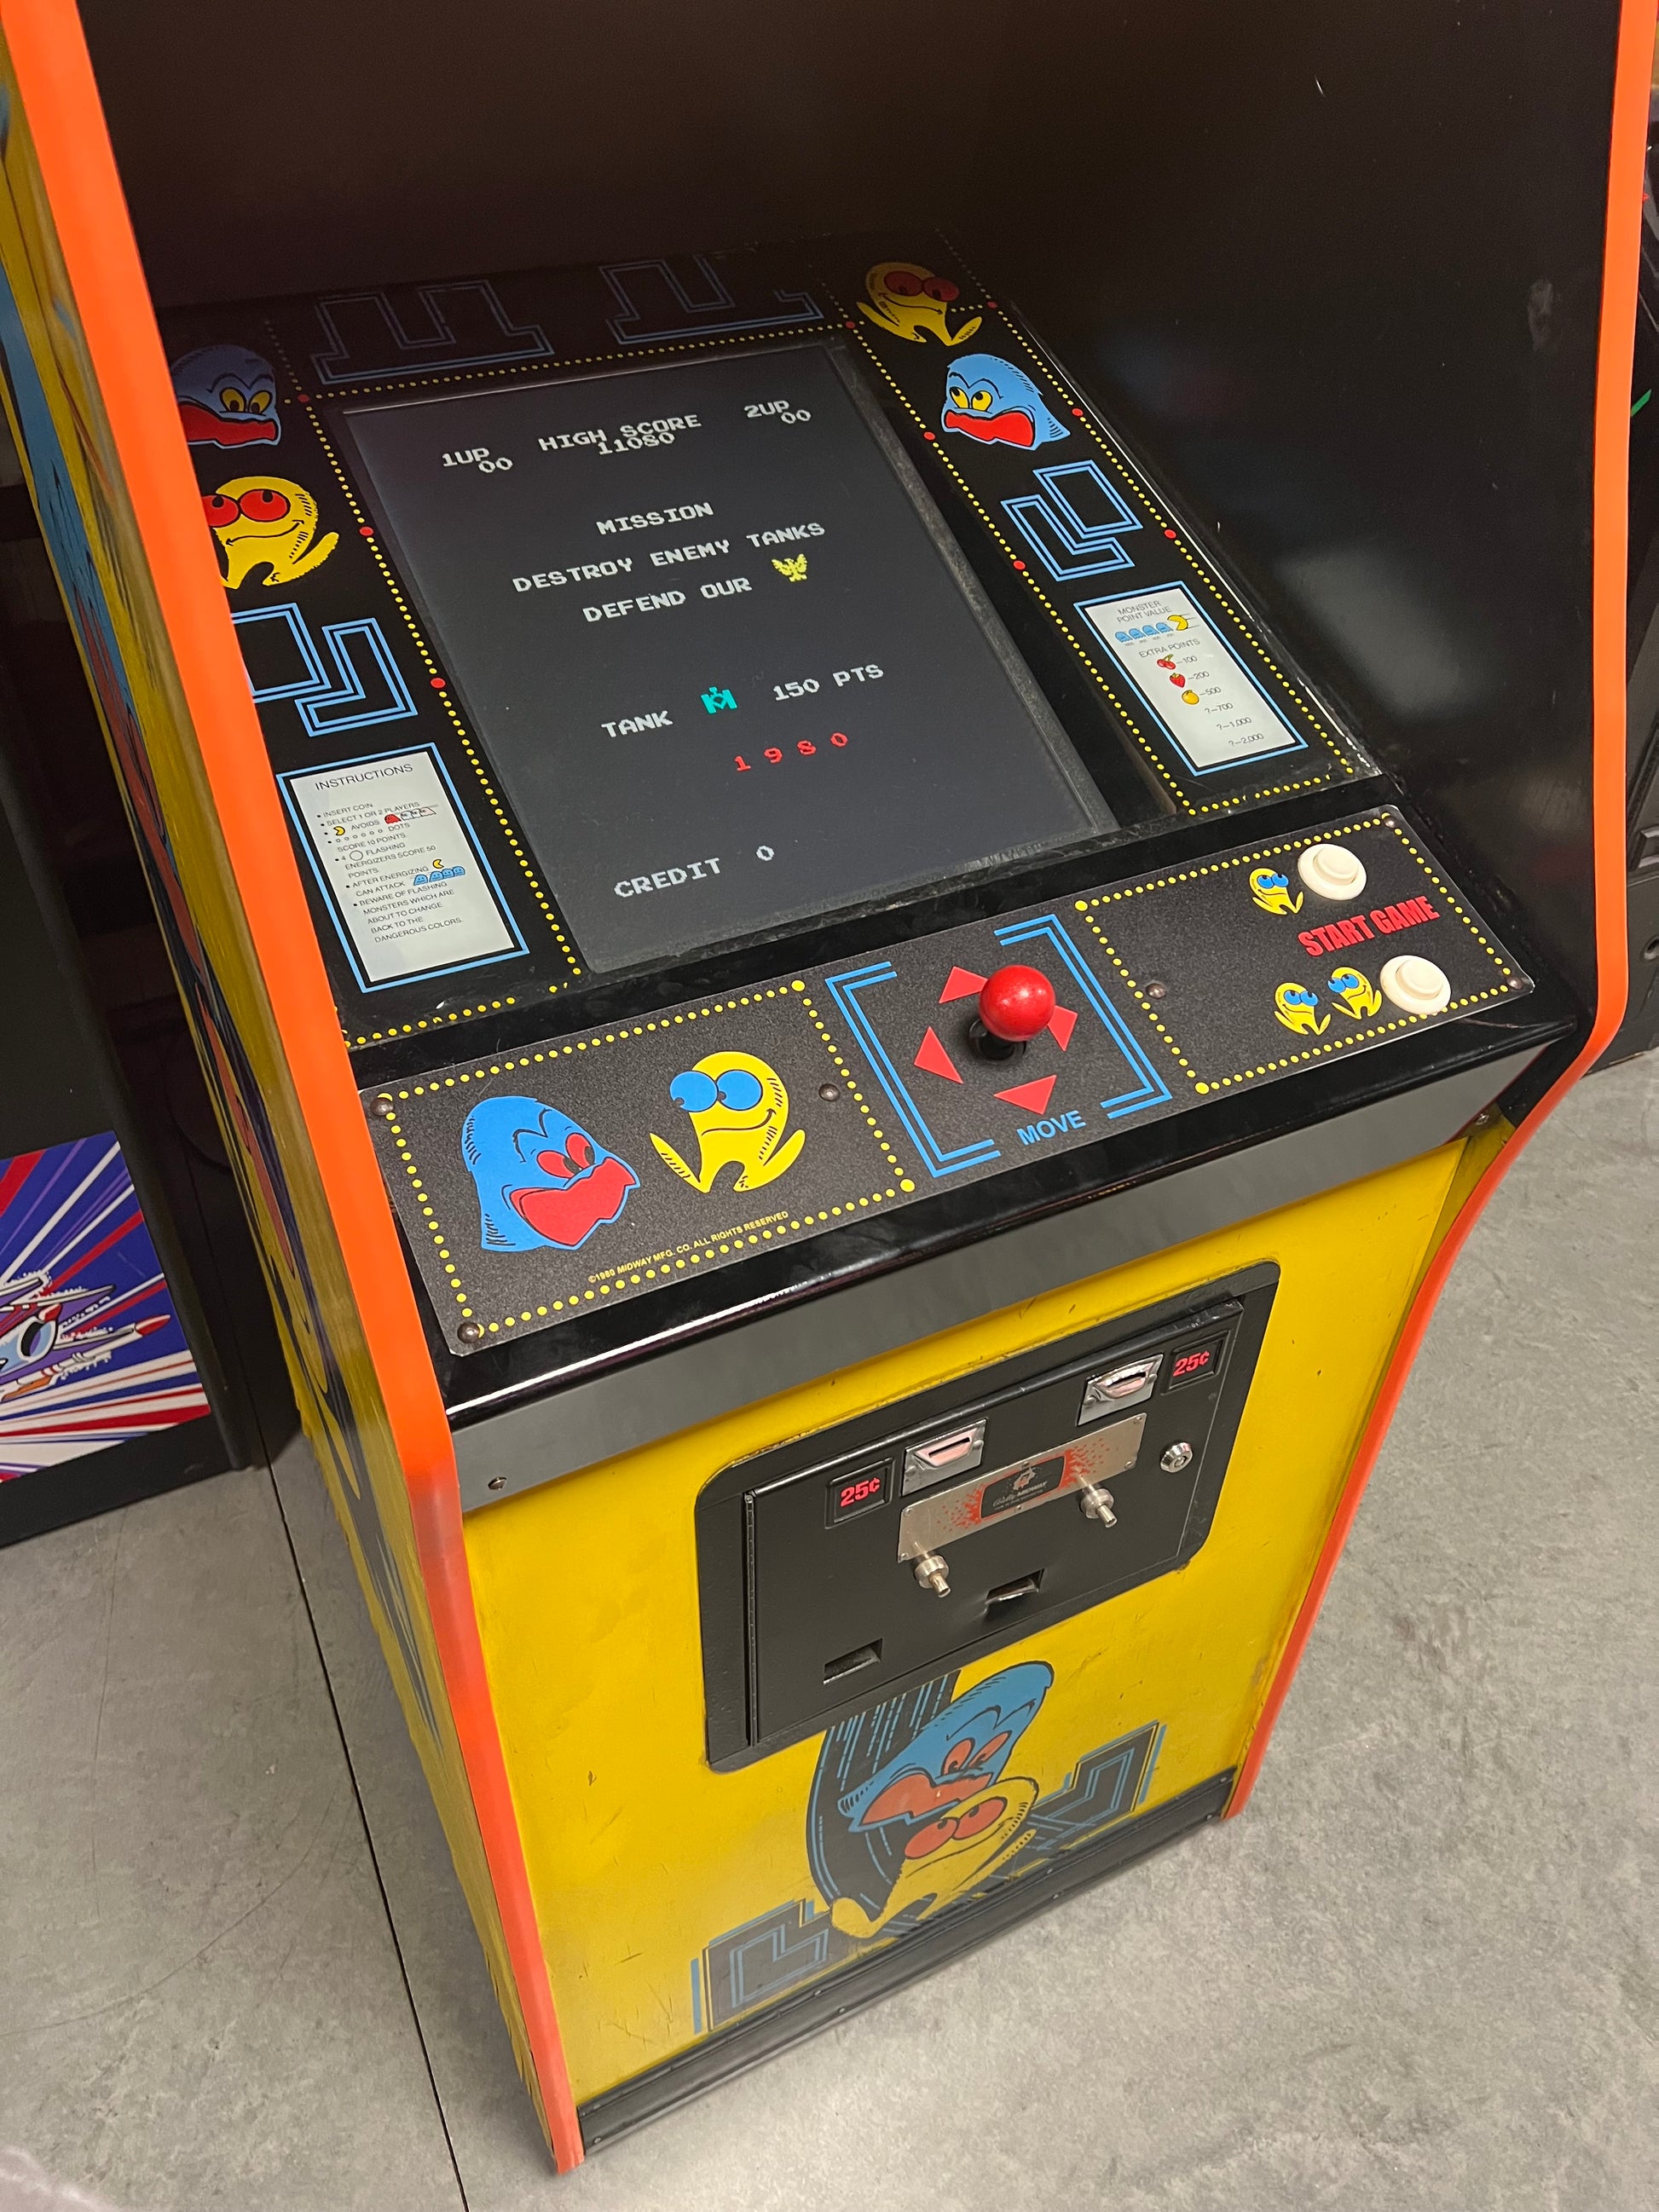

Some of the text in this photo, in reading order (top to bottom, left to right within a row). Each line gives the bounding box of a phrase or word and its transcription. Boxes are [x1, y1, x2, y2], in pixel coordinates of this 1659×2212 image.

[744, 400, 790, 419] 2UP
[781, 410, 812, 424] 00
[538, 414, 702, 451] HIGH SCORE
[598, 432, 675, 454] 11080
[442, 448, 490, 467] 1UP
[478, 458, 513, 473] 00
[596, 502, 714, 535] MISSION
[512, 523, 825, 592] DESTROY ENEMY TANKS
[582, 577, 753, 623] DEFEND OUR
[1118, 600, 1162, 615] MONSTER
[1117, 606, 1173, 623] POINT VALUE
[1138, 646, 1168, 658] EXTRA
[1168, 638, 1200, 650] POINTS
[601, 664, 884, 737] TANK 150 PTS
[315, 764, 413, 791] INSTRUCTIONS
[323, 806, 351, 817] INSERT
[327, 815, 356, 826] SELECT
[384, 801, 420, 813] PLAYERS
[351, 819, 380, 830] AVOIDS
[388, 823, 411, 832] DOTS
[338, 840, 367, 852] SCORE
[377, 832, 406, 843] POINTS
[366, 842, 406, 856] FLASHING
[344, 854, 397, 869] ENERGIZERS
[397, 846, 425, 859] SCORE
[348, 868, 379, 879] POINTS
[352, 866, 429, 887] AFTER ENERGIZING
[614, 845, 775, 898] CREDIT 0
[356, 881, 405, 897] CAN ATTACK
[359, 892, 394, 906] BEWARE
[408, 881, 448, 894] FLASHING
[363, 889, 454, 915] MONSTERS WHICH ARE
[367, 912, 394, 924] ABOUT
[408, 902, 443, 915] CHANGE
[371, 923, 394, 933] BACK
[408, 915, 424, 925] THE
[374, 926, 427, 943] DANGEROUS
[1298, 895, 1441, 956] START GAME
[1016, 1110, 1087, 1146] MOVE
[617, 1256, 653, 1274] MIDWAY
[654, 1249, 676, 1262] MFG.
[676, 1243, 693, 1254] CO.
[693, 1239, 711, 1250] ALL
[711, 1226, 743, 1242] RIGHTS
[743, 1210, 789, 1232] RESERVED
[1172, 1350, 1211, 1378] 25¢
[840, 1476, 882, 1508] 25¢
